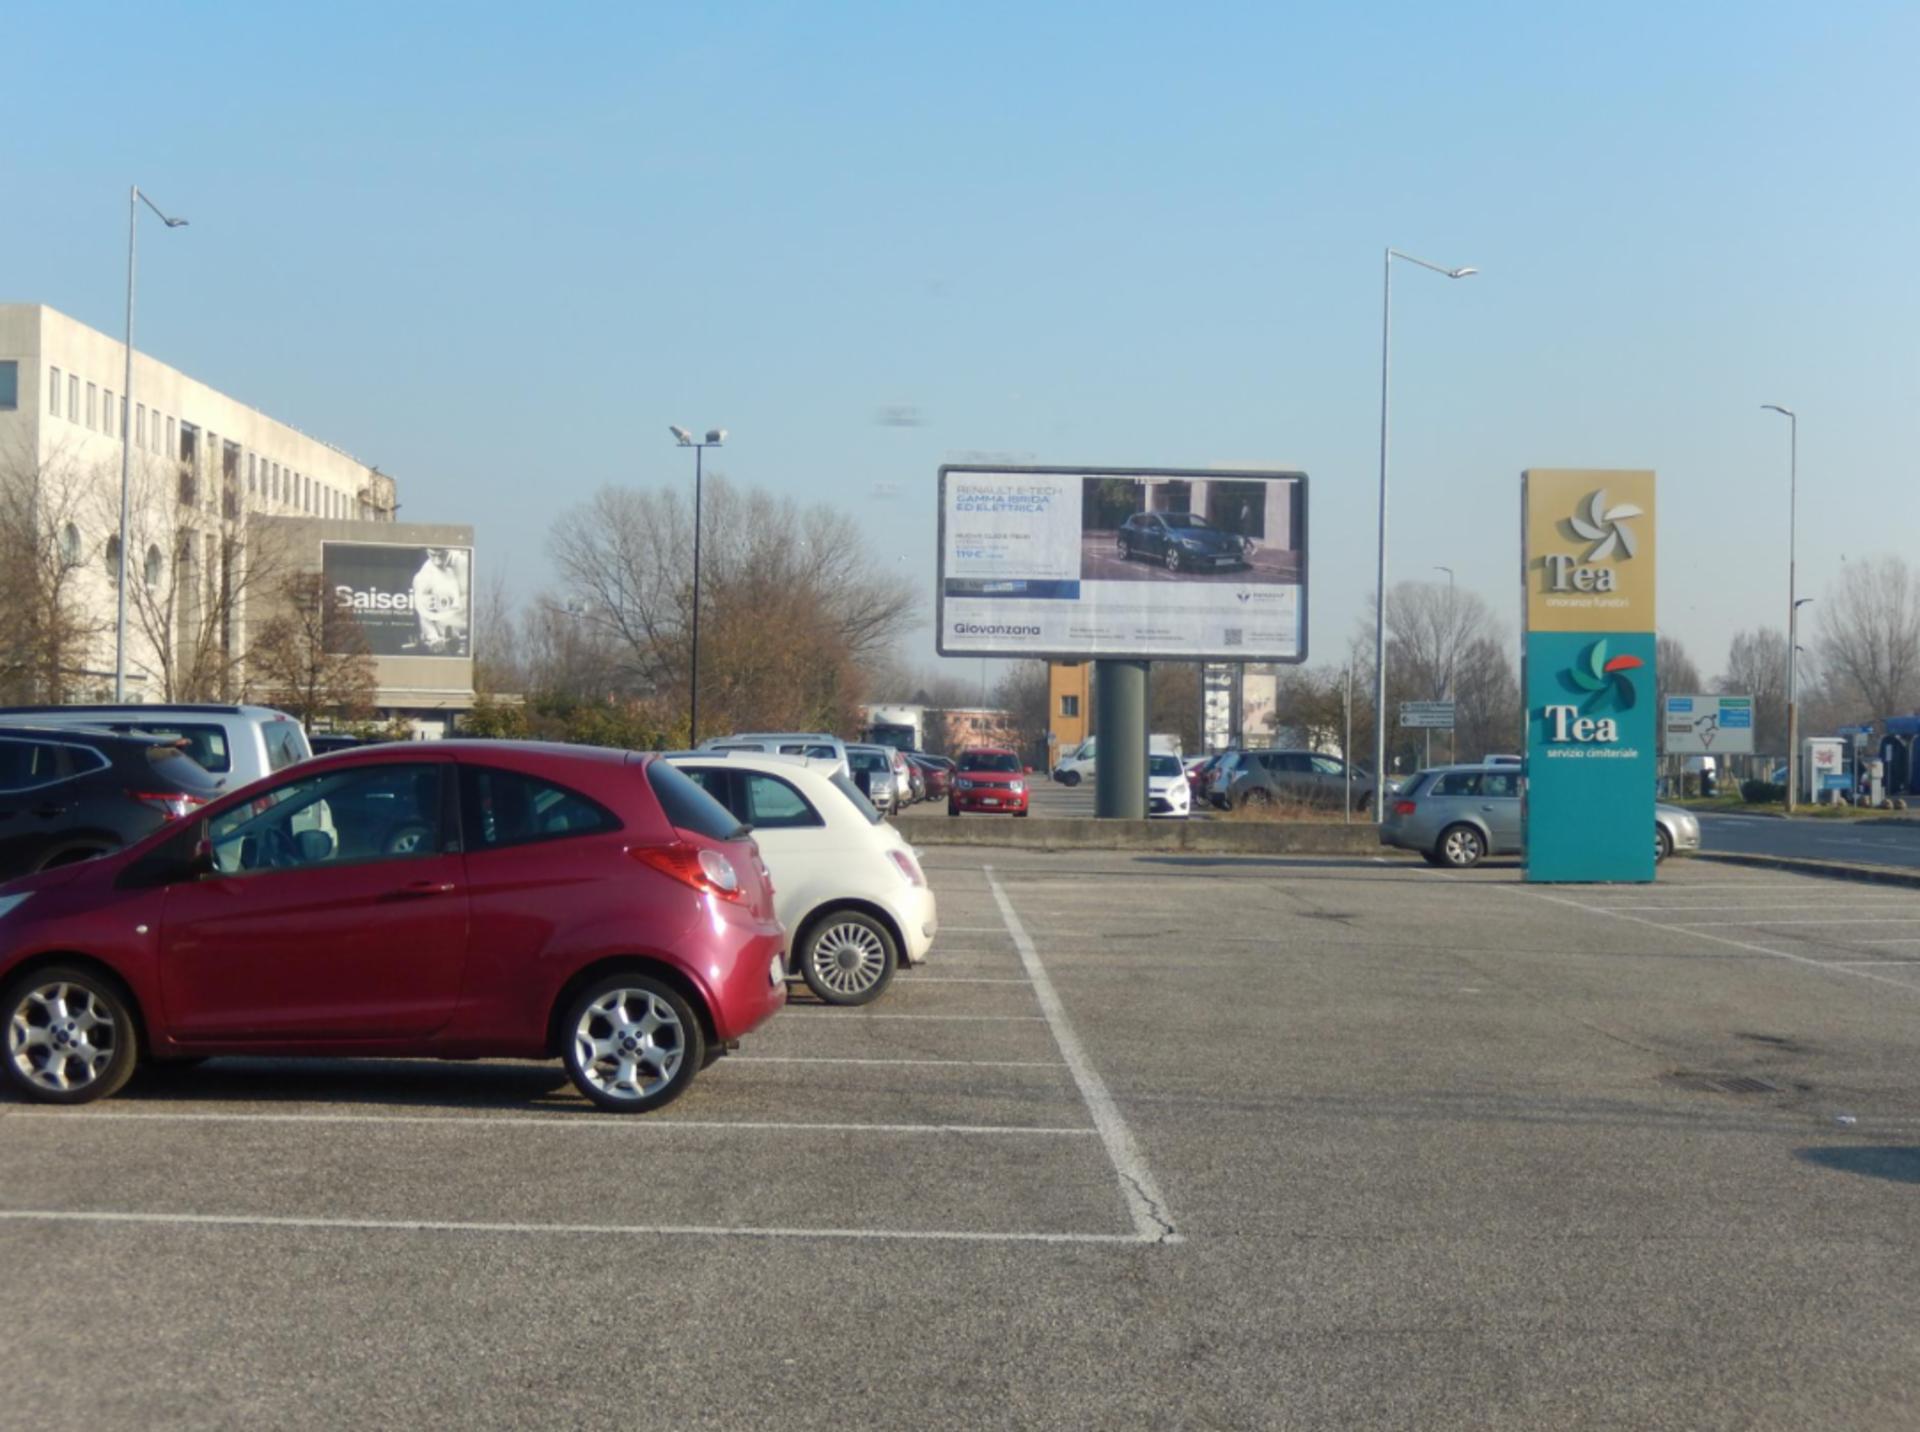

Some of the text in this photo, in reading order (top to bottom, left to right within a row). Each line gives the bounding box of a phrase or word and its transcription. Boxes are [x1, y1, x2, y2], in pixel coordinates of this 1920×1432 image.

[956, 495, 1005, 504] GAMMA
[956, 503, 1045, 513] ED ELETTRICA
[1545, 553, 1616, 592] Tea
[954, 622, 1041, 636] Giovanzana
[1545, 704, 1618, 742] Tea
[1546, 747, 1638, 758] servizio cimiteriale
